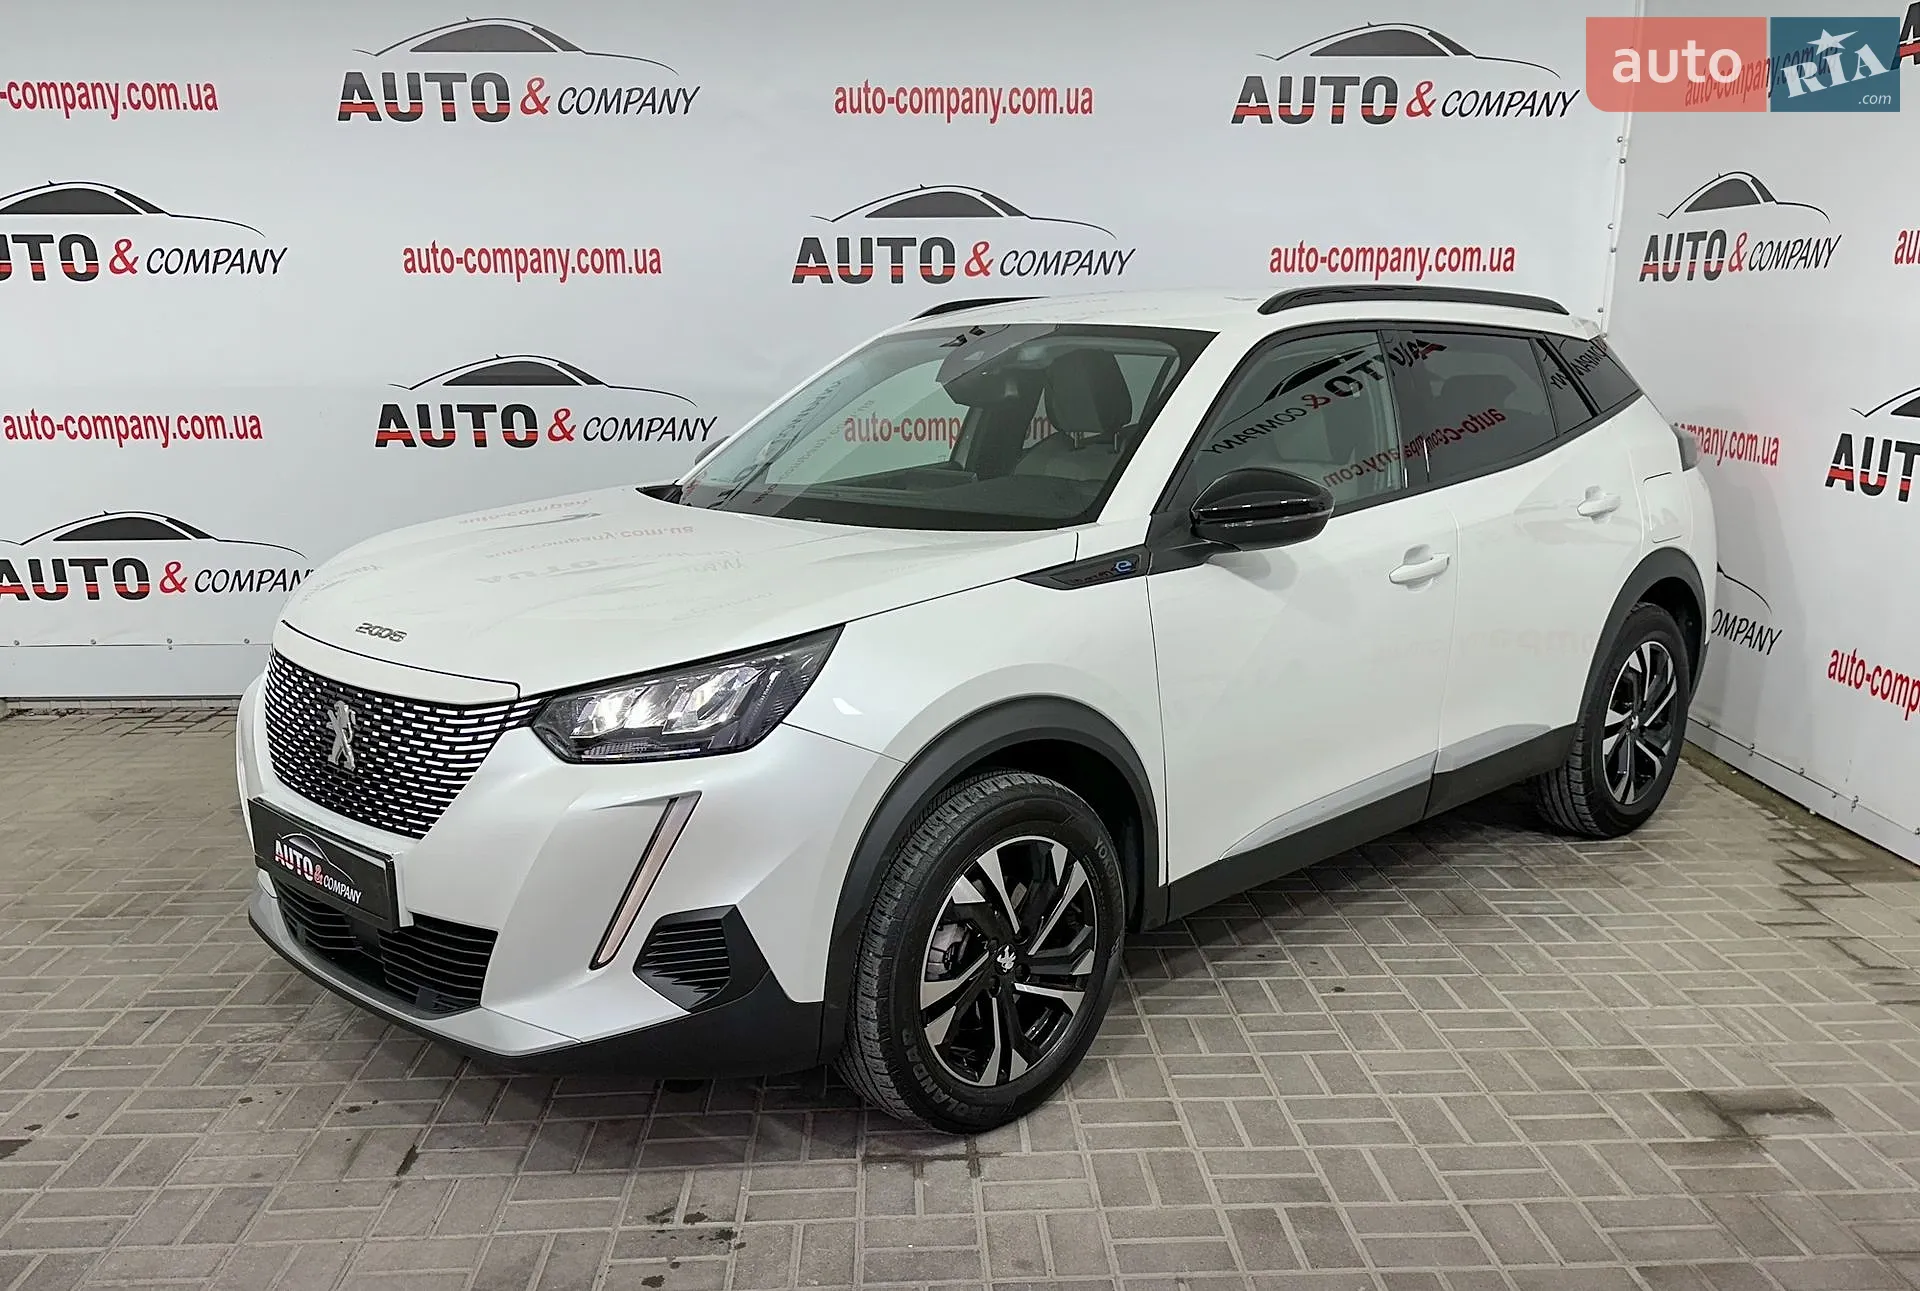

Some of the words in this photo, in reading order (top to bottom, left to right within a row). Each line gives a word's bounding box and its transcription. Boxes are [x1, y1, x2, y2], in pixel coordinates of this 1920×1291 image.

[338, 72, 511, 122] AUTO
[519, 76, 550, 116] &
[557, 86, 700, 116] COMPANY
[834, 79, 1093, 123] auto-company.com.ua
[1232, 75, 1398, 125] AUTO
[1405, 80, 1434, 118] &
[1441, 89, 1580, 118] COMPANY
[108, 239, 139, 275] &
[146, 247, 288, 275] COMPANY
[403, 241, 662, 283] auto-company.com.ua
[792, 237, 955, 284] AUTO
[964, 241, 992, 277] &
[1000, 248, 1135, 277] COMPANY
[1269, 240, 1516, 281] auto-company.com.ua
[1639, 229, 1727, 282] AUTO
[1728, 232, 1747, 273] &
[1748, 234, 1841, 271] COMPANY
[4, 408, 263, 448] auto-company.com.ua
[375, 403, 539, 448] AUTO
[546, 408, 576, 442] &
[583, 415, 718, 444] COMPANY
[159, 561, 188, 594] &
[274, 839, 314, 882] AUTO
[323, 874, 362, 904] COMPANY
